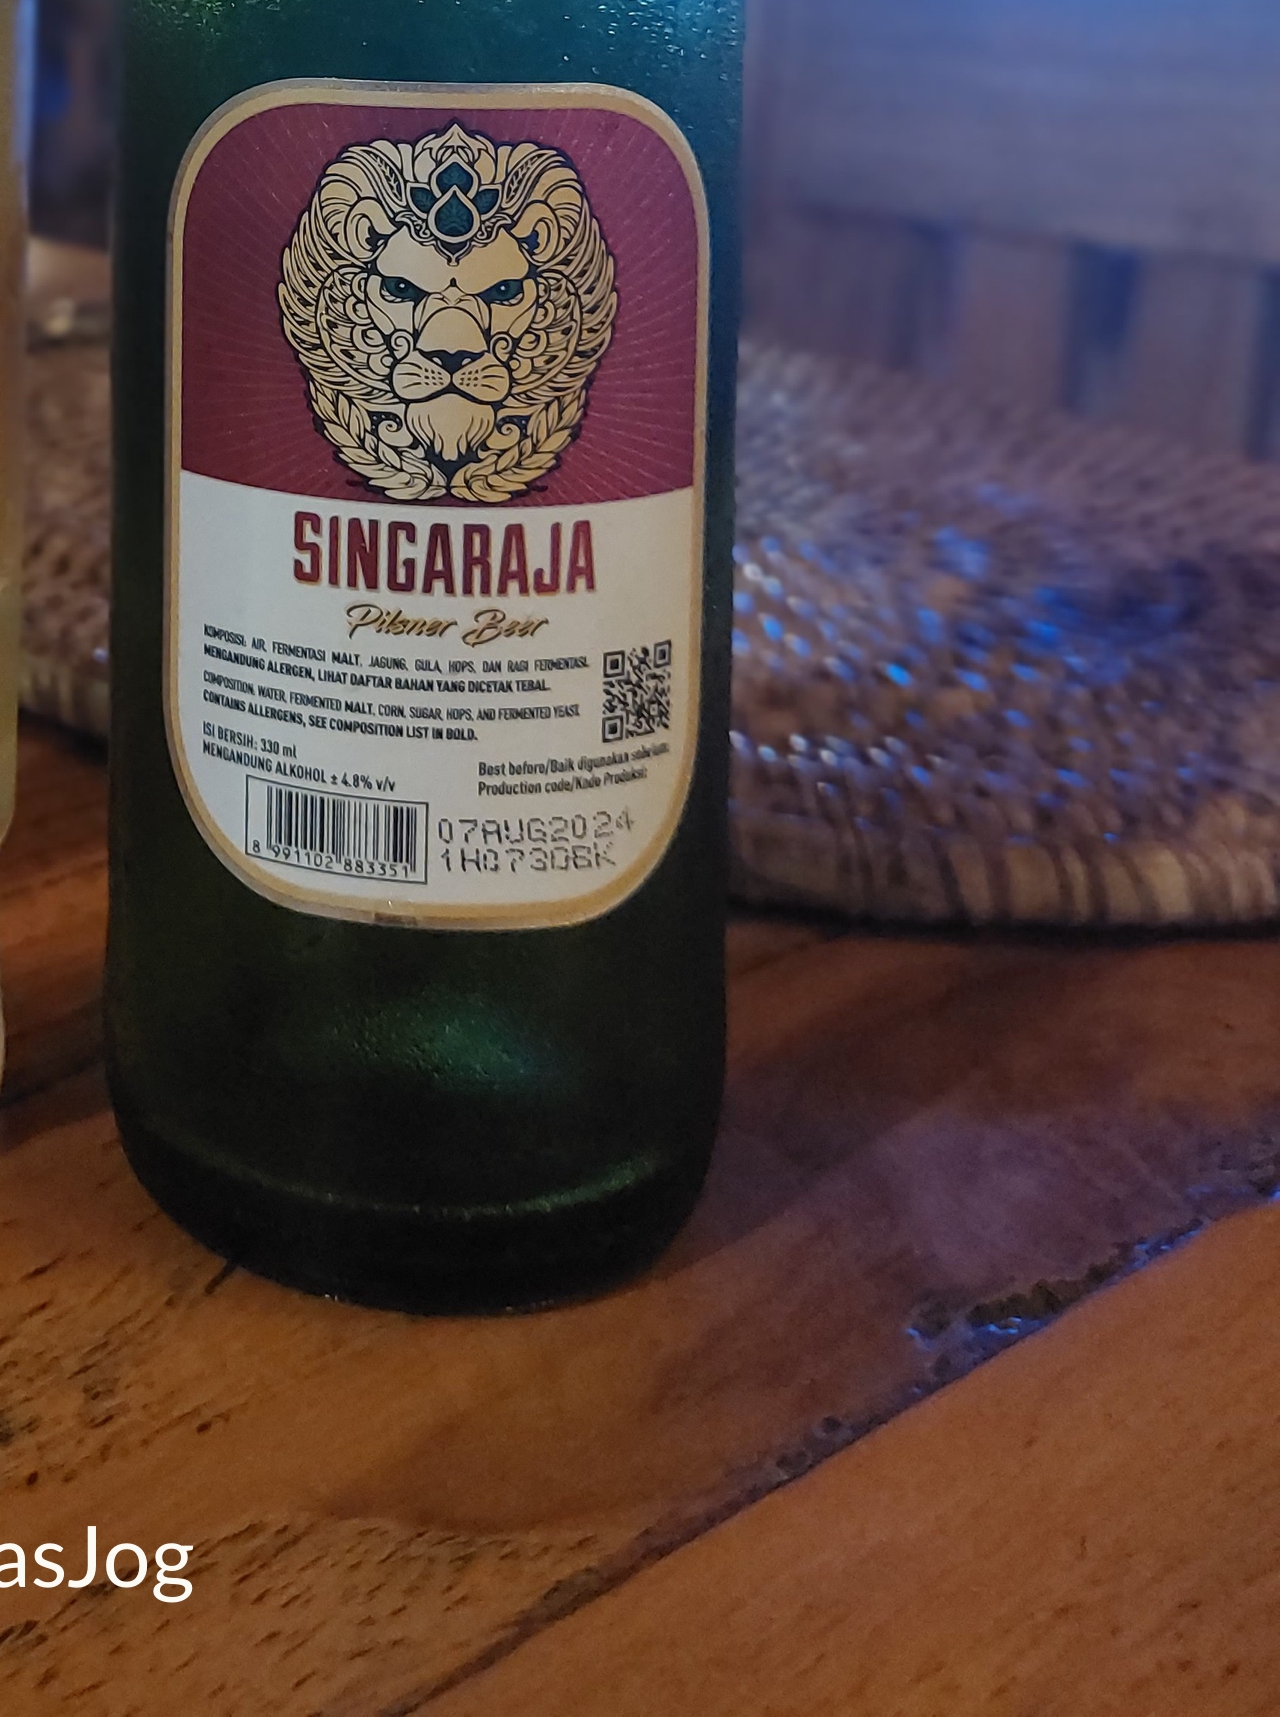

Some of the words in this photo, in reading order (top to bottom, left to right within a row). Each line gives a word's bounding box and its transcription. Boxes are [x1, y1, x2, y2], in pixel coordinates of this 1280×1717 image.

[293, 510, 596, 596] SINGARAJA
[346, 603, 458, 640] Pilsner
[462, 608, 550, 648] Beer
[203, 643, 265, 671] MENGANDUNG
[267, 659, 315, 681] ALERGEN,
[318, 668, 348, 685] LIHAT
[350, 673, 392, 689] DAFTAR
[395, 677, 434, 692] BAHAN
[437, 679, 465, 693] YANG
[468, 679, 513, 693] DICETAK
[272, 641, 326, 662] FERMENTASI
[482, 660, 501, 673] DAN
[507, 659, 528, 672] RAGI
[203, 689, 246, 712] CONTAINS
[247, 701, 306, 728] ALLERGENS,
[308, 714, 327, 729] SEE
[329, 718, 403, 738] COMPOSITION
[406, 725, 429, 739] LIST
[432, 727, 443, 740] IN
[445, 727, 478, 741] BOLD.
[289, 691, 342, 711] FERMENTED
[476, 707, 496, 721] AND
[498, 706, 551, 721] FERMENTED
[203, 720, 215, 735] ISI
[217, 725, 257, 751] BERSIH:
[261, 737, 280, 755] 330
[282, 743, 297, 759] ml
[203, 739, 272, 772] MENGANDUNG
[275, 761, 327, 784] ALKOHOL
[341, 772, 373, 790] 4.8%
[375, 776, 396, 792] v/v
[478, 761, 506, 777] Best
[508, 757, 575, 776] before/Baik
[577, 751, 629, 772] digunakan
[478, 780, 542, 796] Production
[544, 775, 602, 793] code/Kode
[252, 839, 261, 854] 8
[271, 844, 334, 869] 991102
[343, 858, 409, 878] 883351
